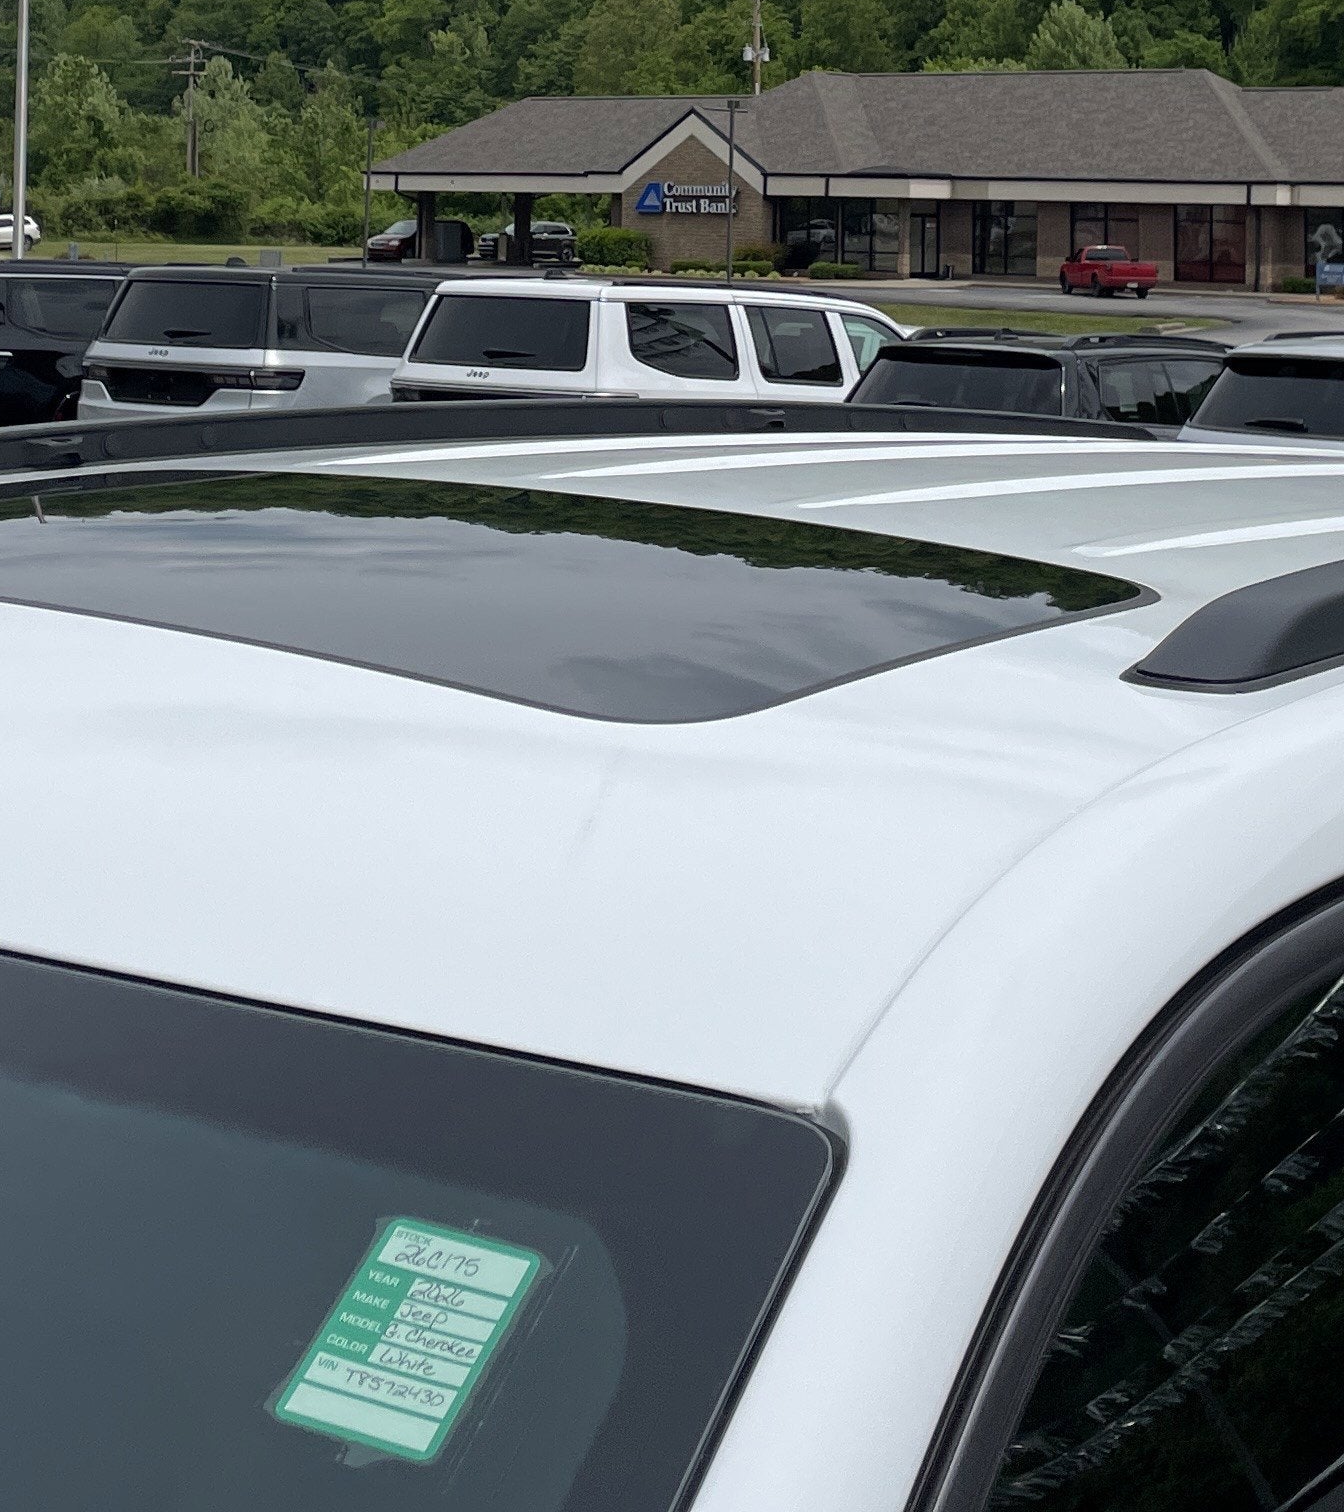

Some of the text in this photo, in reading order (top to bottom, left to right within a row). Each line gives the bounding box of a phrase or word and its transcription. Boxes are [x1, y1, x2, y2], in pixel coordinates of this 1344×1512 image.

[663, 198, 697, 213] Trust
[466, 369, 490, 379] Jeep
[395, 1229, 432, 1246] STOCK
[368, 1269, 400, 1287] YEAR
[352, 1290, 390, 1309] MAKE
[411, 1279, 465, 1308] 2026
[340, 1311, 383, 1333] MODEL
[399, 1304, 448, 1328] Jeep
[327, 1332, 369, 1354] COLOR
[406, 1328, 475, 1360] Cherokee
[318, 1355, 339, 1372] VIN
[379, 1348, 436, 1376] White
